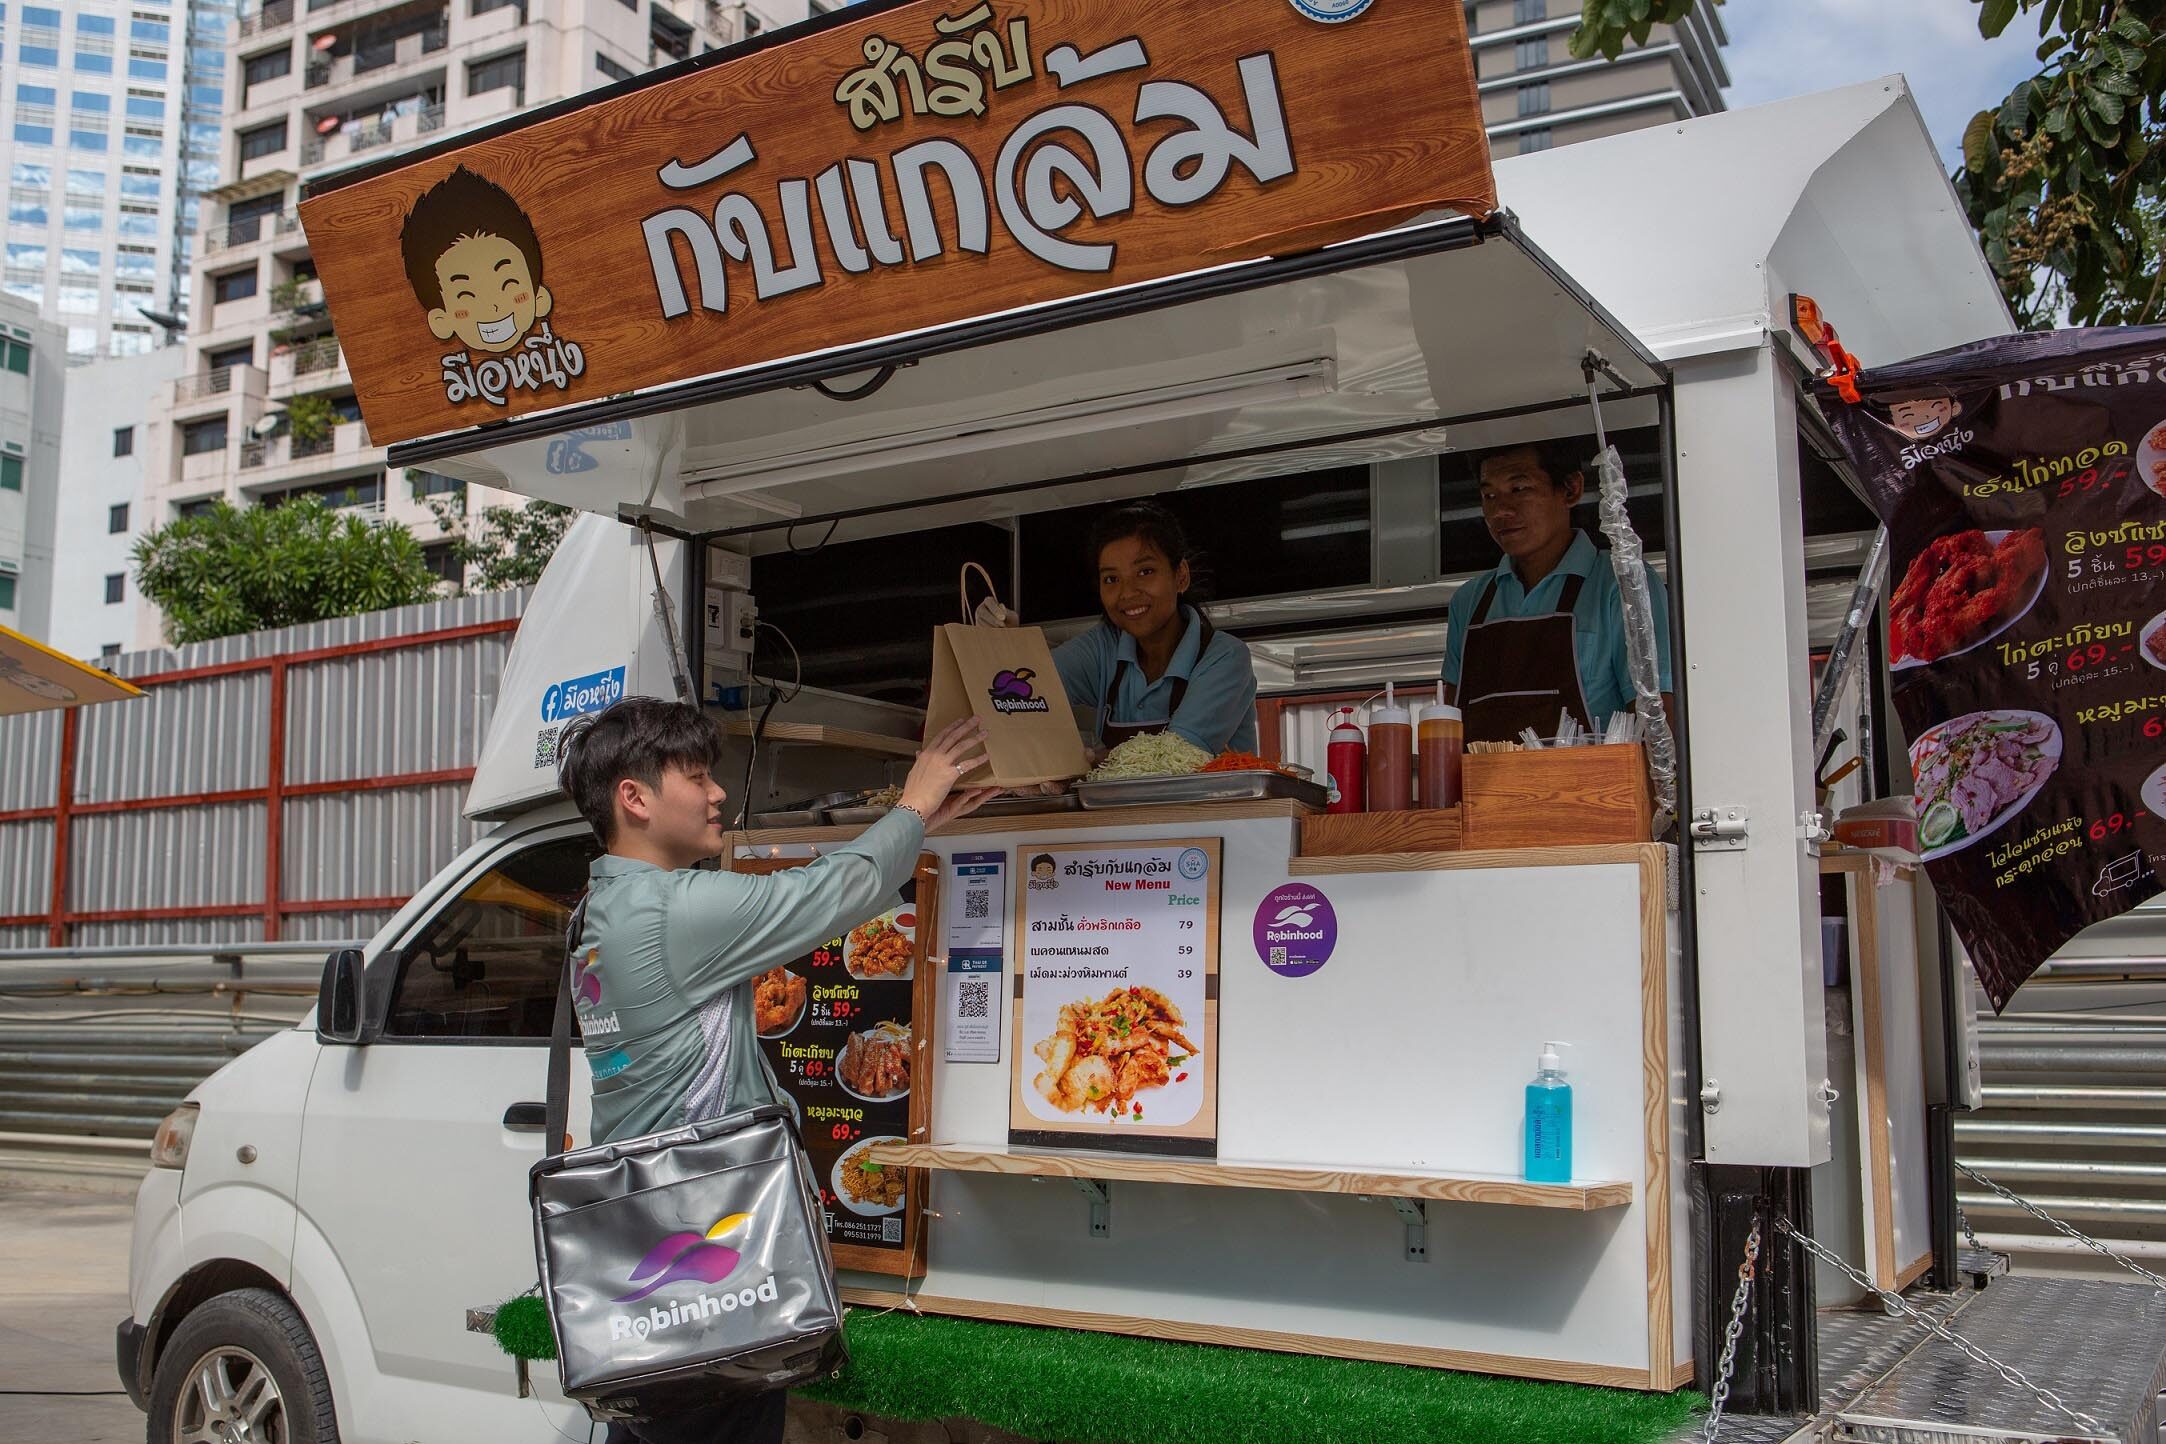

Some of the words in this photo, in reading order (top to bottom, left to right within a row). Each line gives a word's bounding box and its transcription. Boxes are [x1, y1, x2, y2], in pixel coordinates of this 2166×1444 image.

[835, 2, 1033, 131] สำรับ
[641, 36, 1297, 319] กับแกล้ม
[440, 320, 586, 407] มือหนึ่ง
[1963, 440, 2128, 498] เอ็นไก่ทอด
[2067, 559, 2082, 578] 5
[2091, 553, 2116, 573] ชิ้น
[2124, 543, 2166, 569] 59
[1996, 621, 2132, 666] ไก่ตะเกียบ
[2027, 660, 2040, 680] 5
[2066, 643, 2134, 671] 69.-
[994, 697, 1047, 714] Robinhood
[2089, 811, 2146, 841] 69.-
[1064, 857, 1172, 878] สำรับกับแกล้ม
[1995, 836, 2083, 889] กระดูกอ่อน
[1105, 879, 1132, 891] New
[1135, 879, 1171, 890] Menu
[1167, 894, 1200, 906] Price
[1031, 914, 1075, 932] สามชั้น
[1179, 920, 1194, 930] 79
[1266, 930, 1324, 943] Robinhood
[812, 951, 840, 967] 59.-
[1031, 945, 1109, 956] เบคอนแหนมสด
[1178, 946, 1193, 955] 59
[1030, 967, 1129, 979] เม็ดมะม่วงหิมพานต์
[1177, 969, 1192, 979] 39
[812, 1003, 819, 1017] 5
[833, 1001, 860, 1018] 59.-
[790, 1060, 797, 1073] 5
[805, 1060, 833, 1077] 69.-
[832, 1124, 860, 1140] 69.-
[610, 1275, 778, 1343] Robinhood
